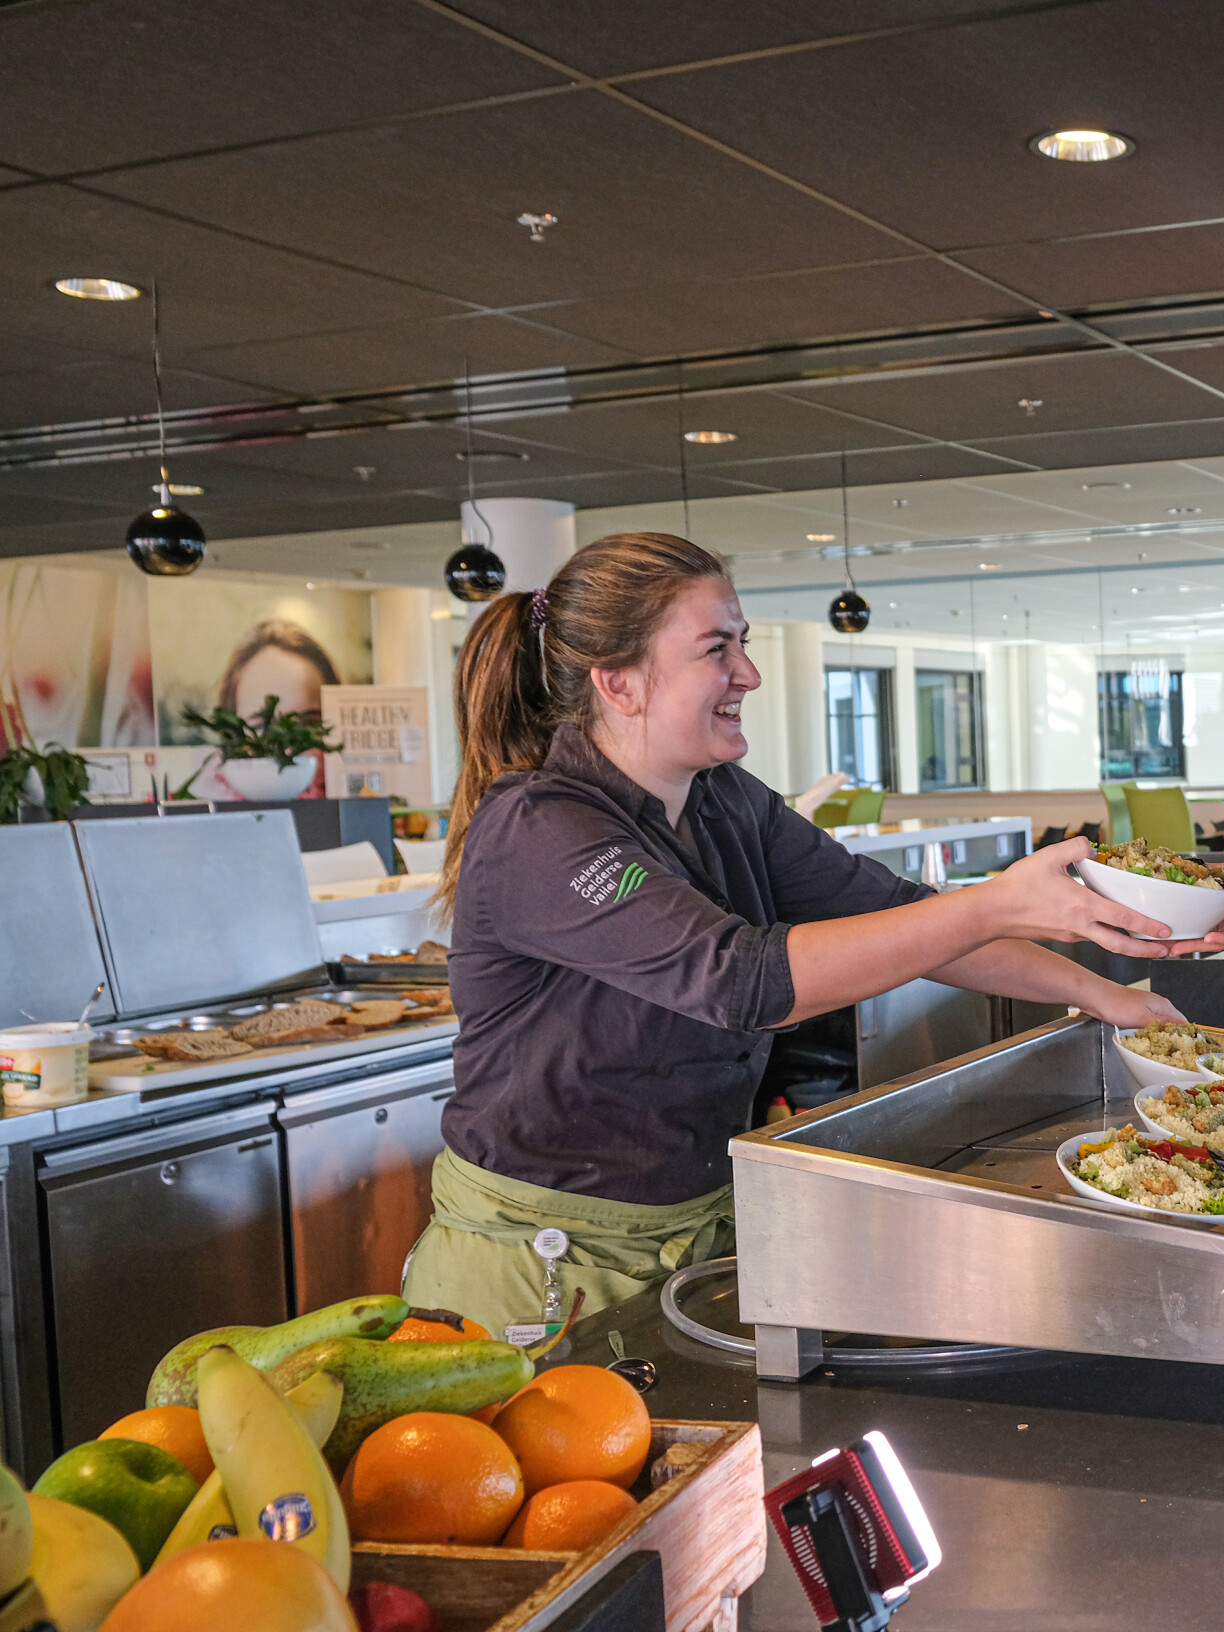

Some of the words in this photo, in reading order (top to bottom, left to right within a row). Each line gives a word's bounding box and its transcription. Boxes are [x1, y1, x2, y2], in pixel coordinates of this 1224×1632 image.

[340, 704, 410, 726] HEALTHY
[342, 728, 397, 750] FRIDGE
[569, 846, 622, 892] Ziekenhuis
[581, 861, 623, 898] Gelderse
[589, 878, 618, 906] Vallei
